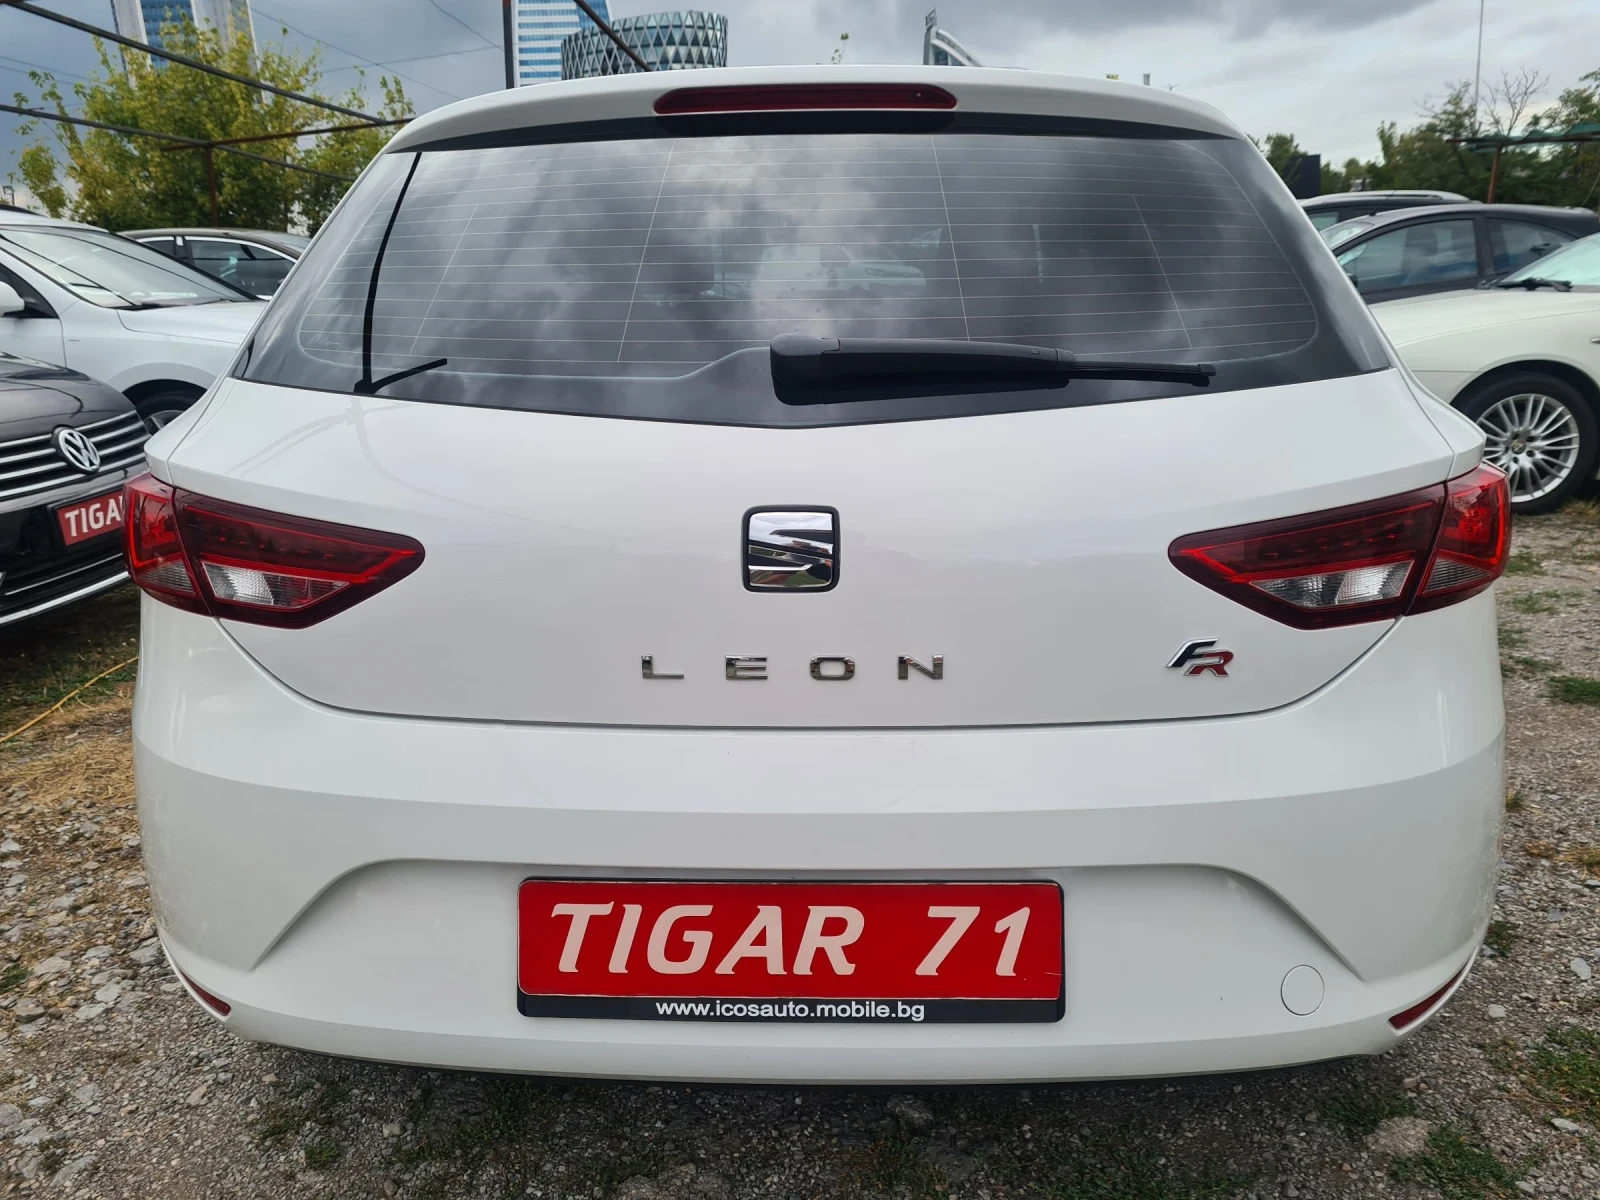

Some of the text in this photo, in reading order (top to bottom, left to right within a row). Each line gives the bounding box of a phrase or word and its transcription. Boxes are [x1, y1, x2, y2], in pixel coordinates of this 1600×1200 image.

[64, 495, 123, 537] TIGA
[641, 653, 944, 680] LEON
[1165, 637, 1234, 677] FR
[550, 901, 1031, 976] TIGAR 71
[655, 1000, 925, 1021] www.icosauto.mobile.bg
